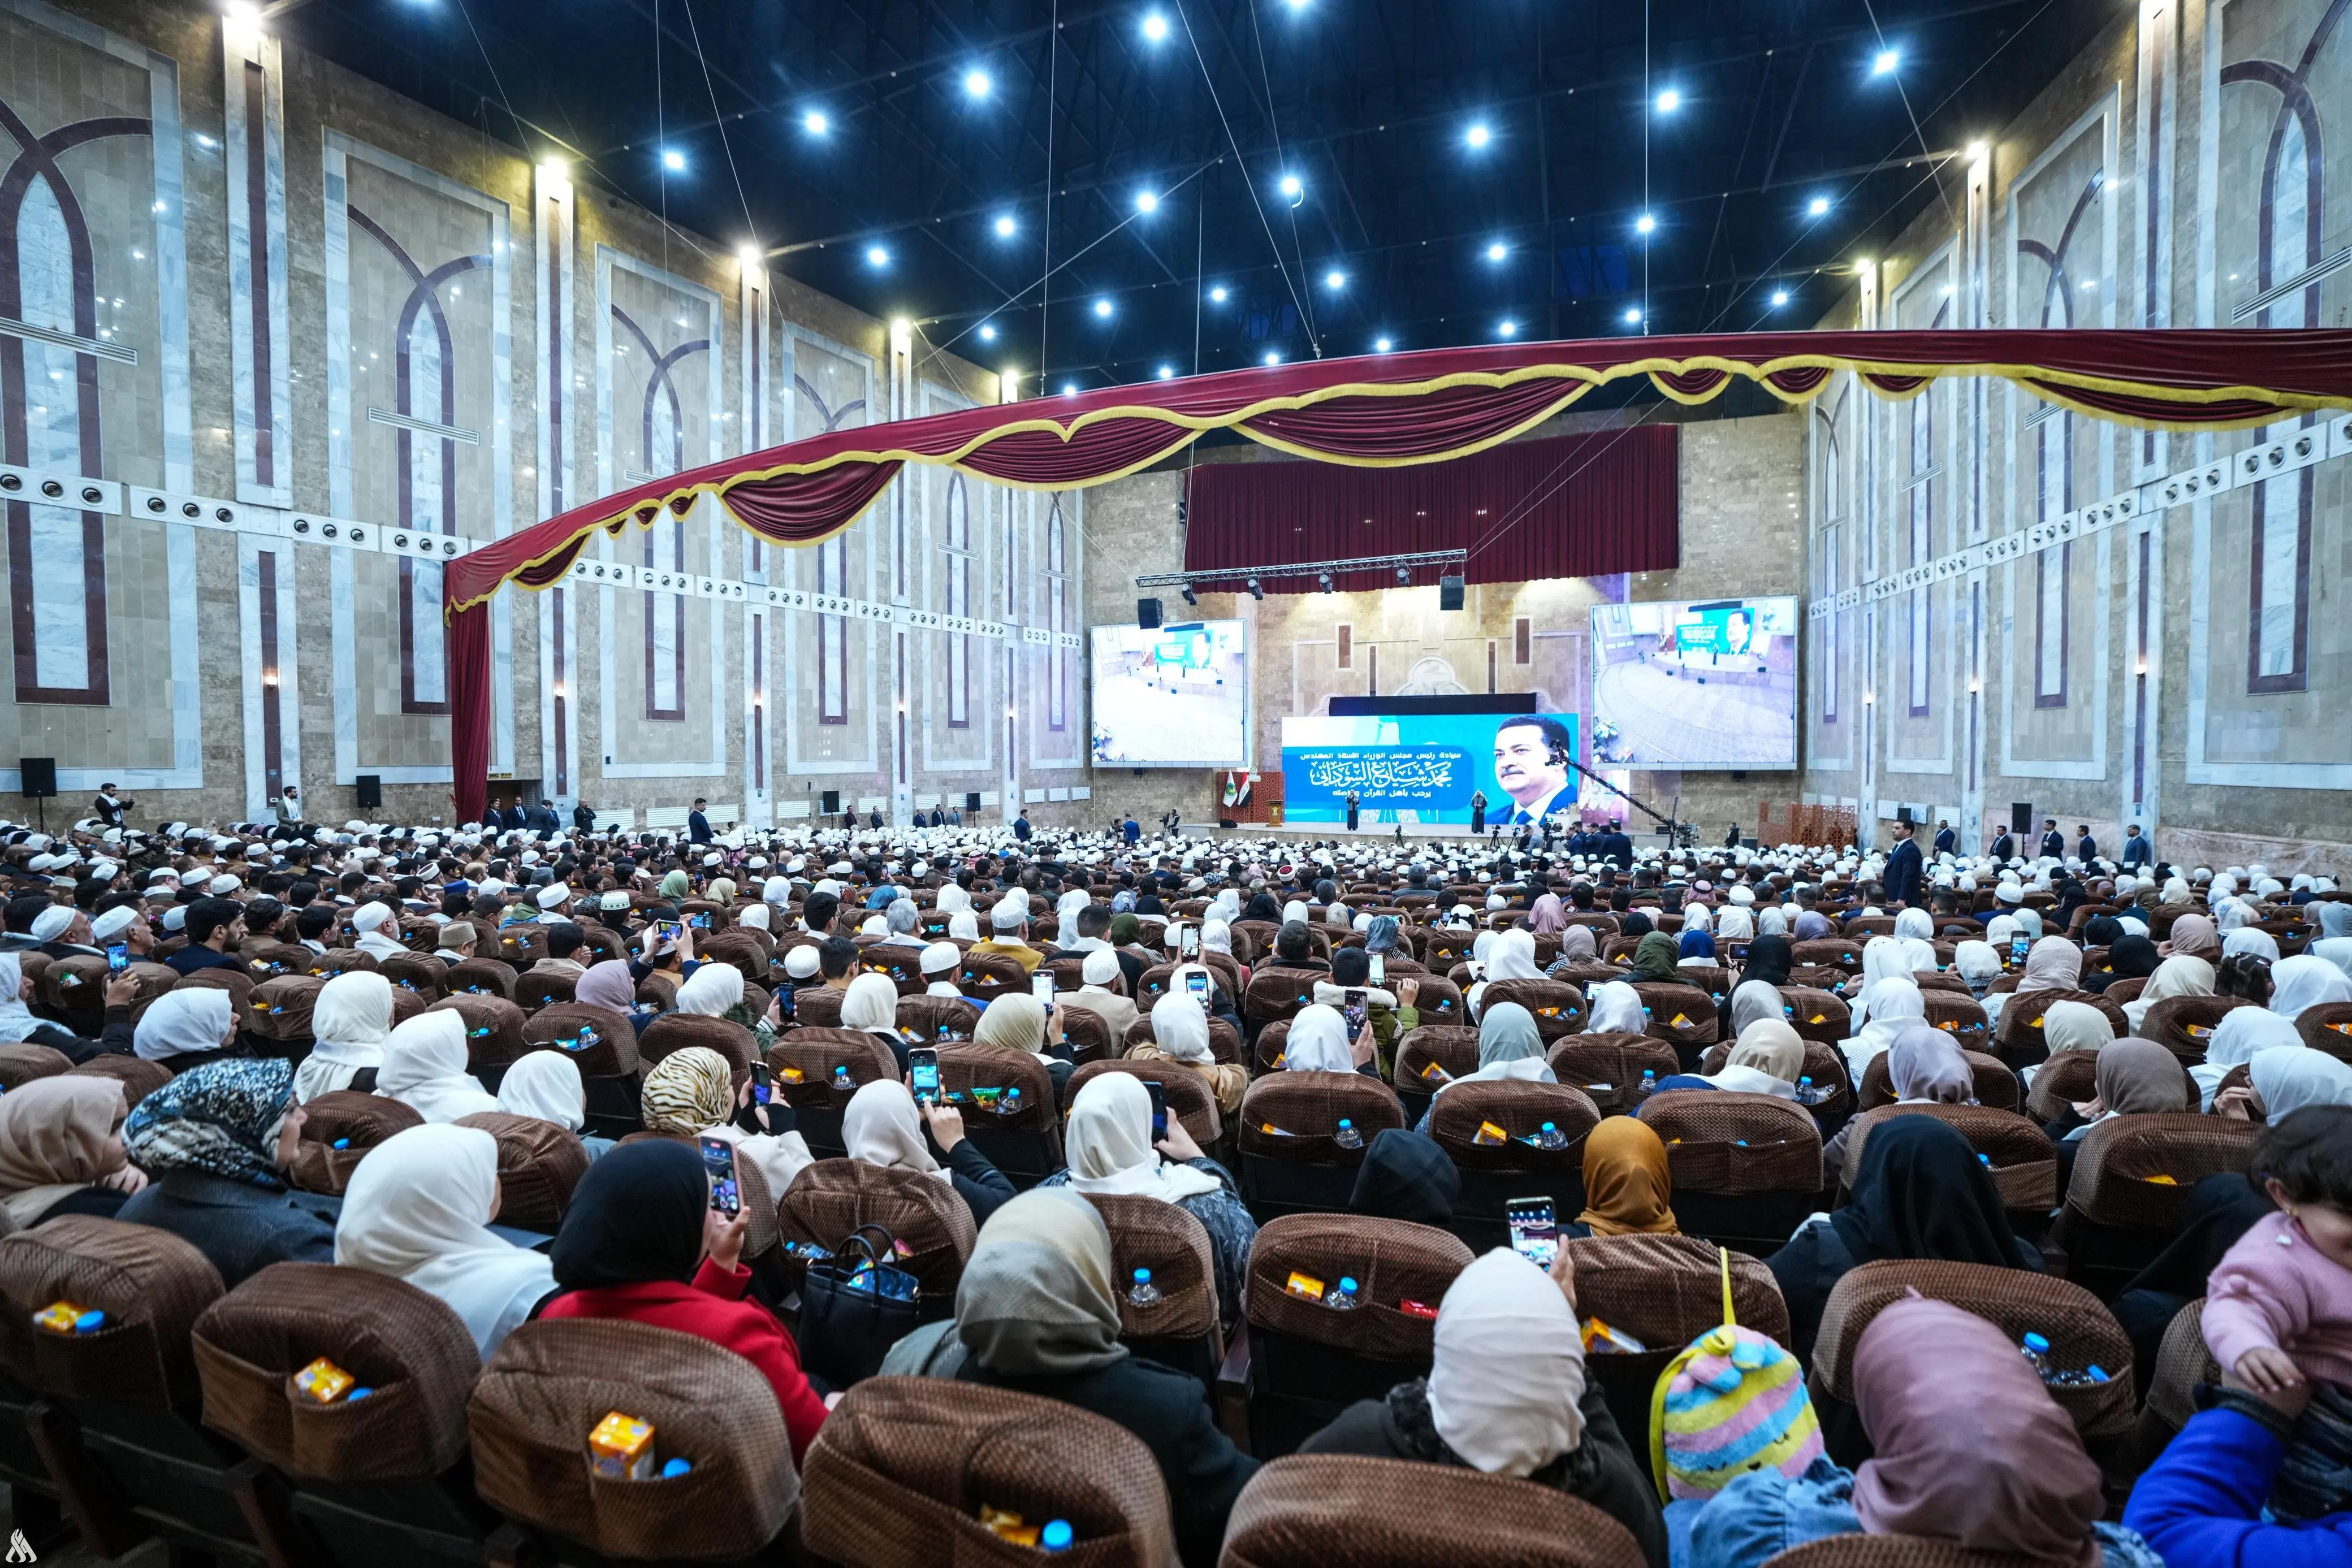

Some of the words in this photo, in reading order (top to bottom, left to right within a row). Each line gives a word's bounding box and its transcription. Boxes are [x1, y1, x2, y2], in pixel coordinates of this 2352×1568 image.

[1421, 761, 1452, 787] محمد
[1363, 789, 1386, 798] القرآن
[1389, 789, 1408, 797] بأهل
